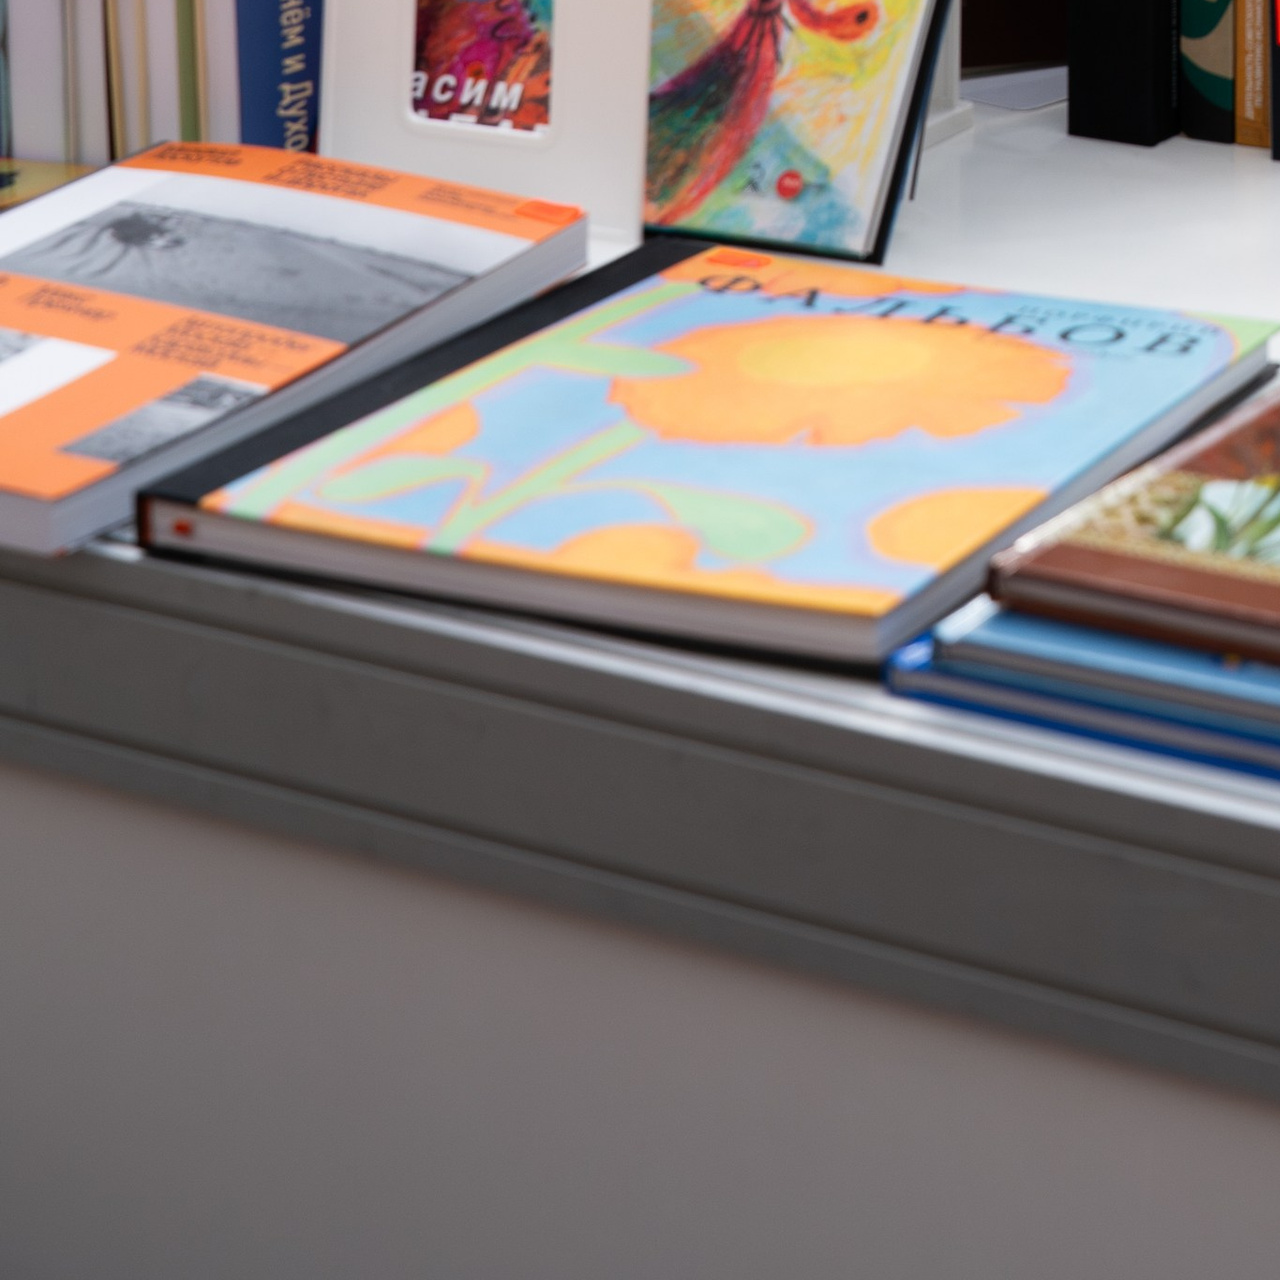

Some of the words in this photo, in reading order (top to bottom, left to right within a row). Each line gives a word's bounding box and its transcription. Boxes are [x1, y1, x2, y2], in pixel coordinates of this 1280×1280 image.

[281, 52, 306, 76] и
[412, 70, 524, 111] асим
[276, 79, 314, 153] Духо
